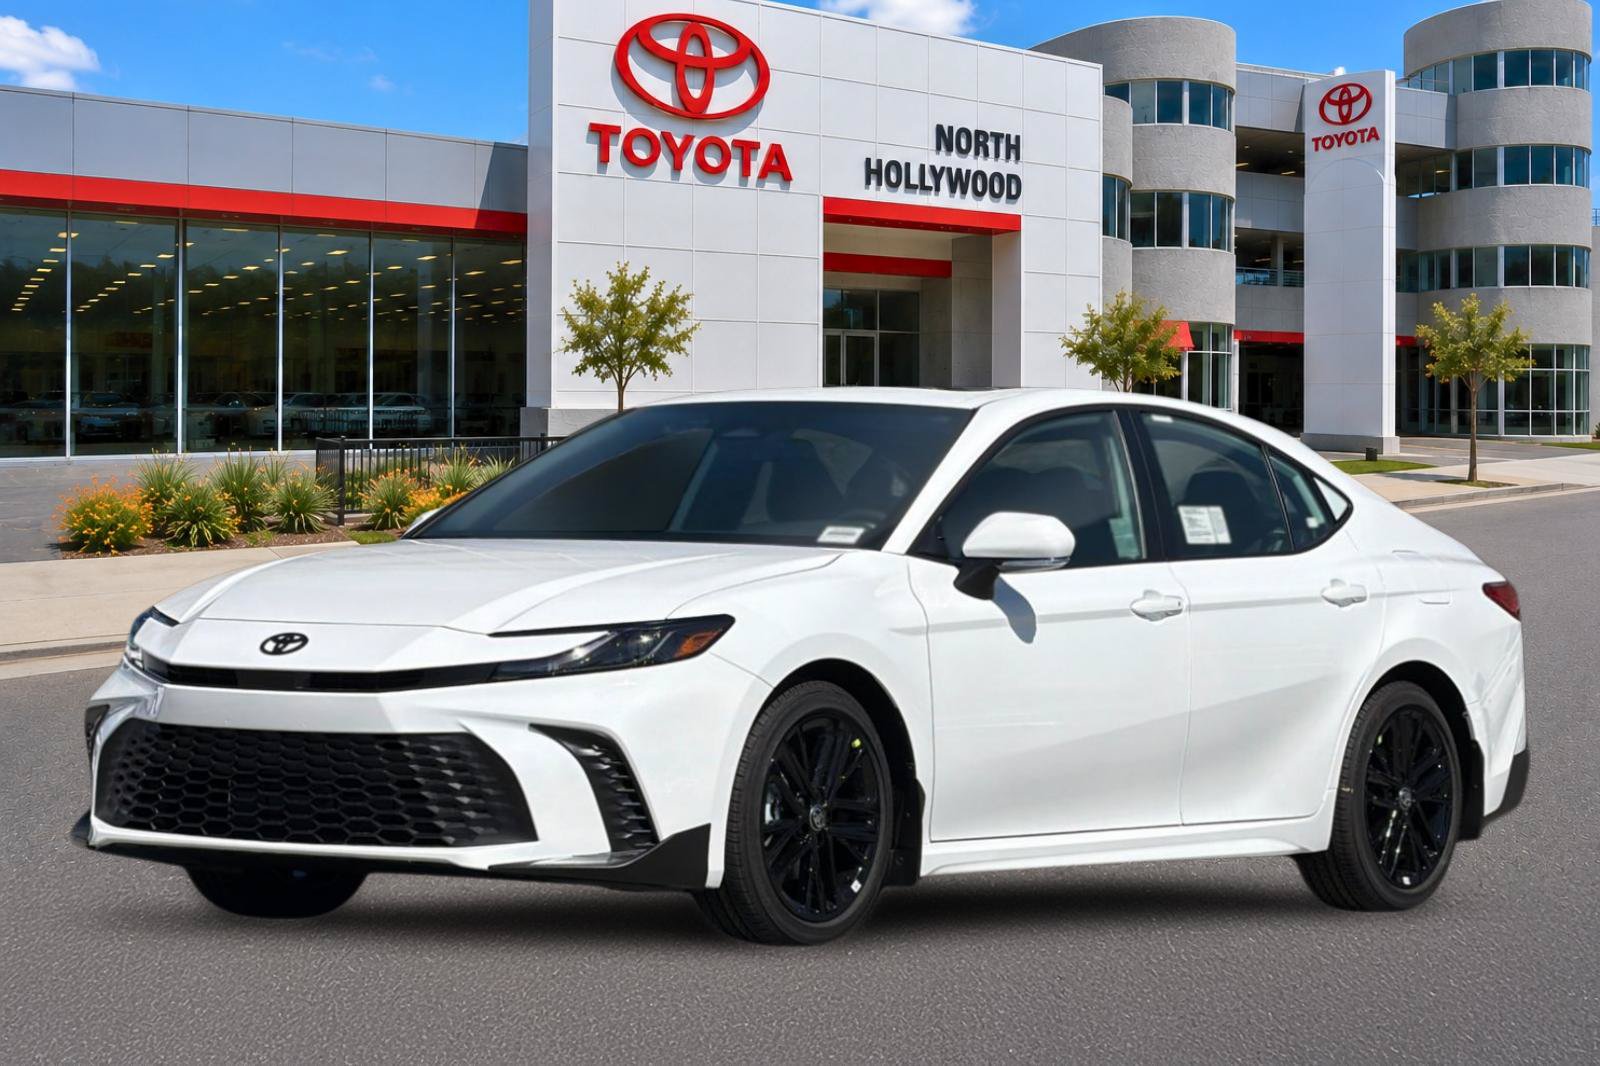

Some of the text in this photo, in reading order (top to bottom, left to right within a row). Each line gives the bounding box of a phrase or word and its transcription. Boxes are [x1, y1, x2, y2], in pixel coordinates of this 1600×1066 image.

[588, 122, 793, 182] TOYOTA
[935, 124, 1022, 162] NORTH
[1312, 126, 1380, 152] TOYOTA
[864, 157, 1022, 201] HOLLYWOOD
